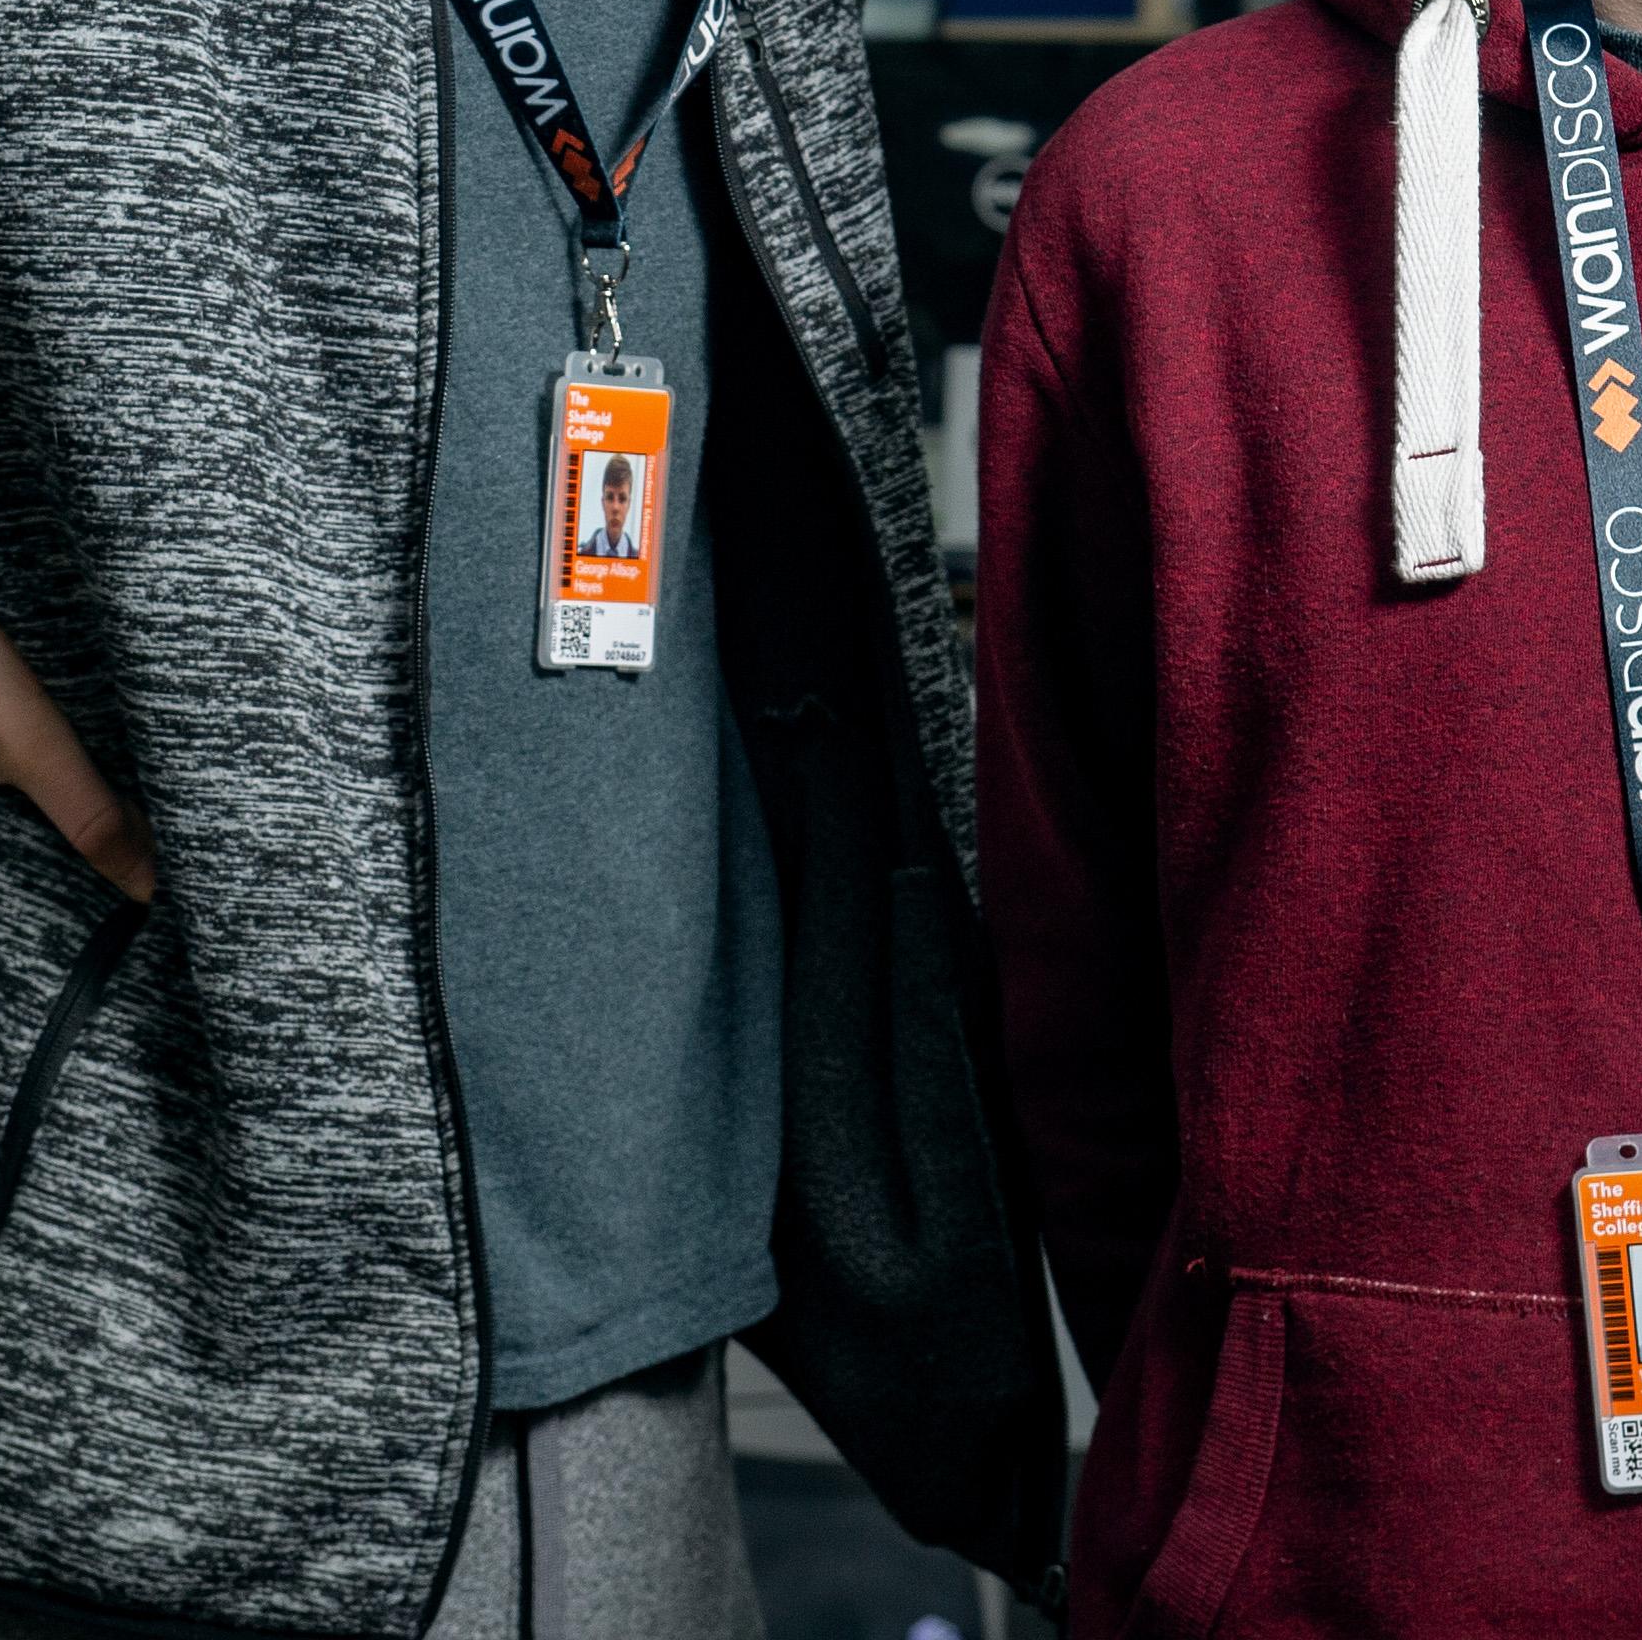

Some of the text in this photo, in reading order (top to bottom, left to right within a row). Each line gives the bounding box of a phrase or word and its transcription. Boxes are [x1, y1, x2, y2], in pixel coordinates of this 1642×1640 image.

[569, 389, 591, 408] The
[566, 425, 606, 445] College
[1588, 1181, 1624, 1199] The
[1608, 1422, 1622, 1477] Scan me
